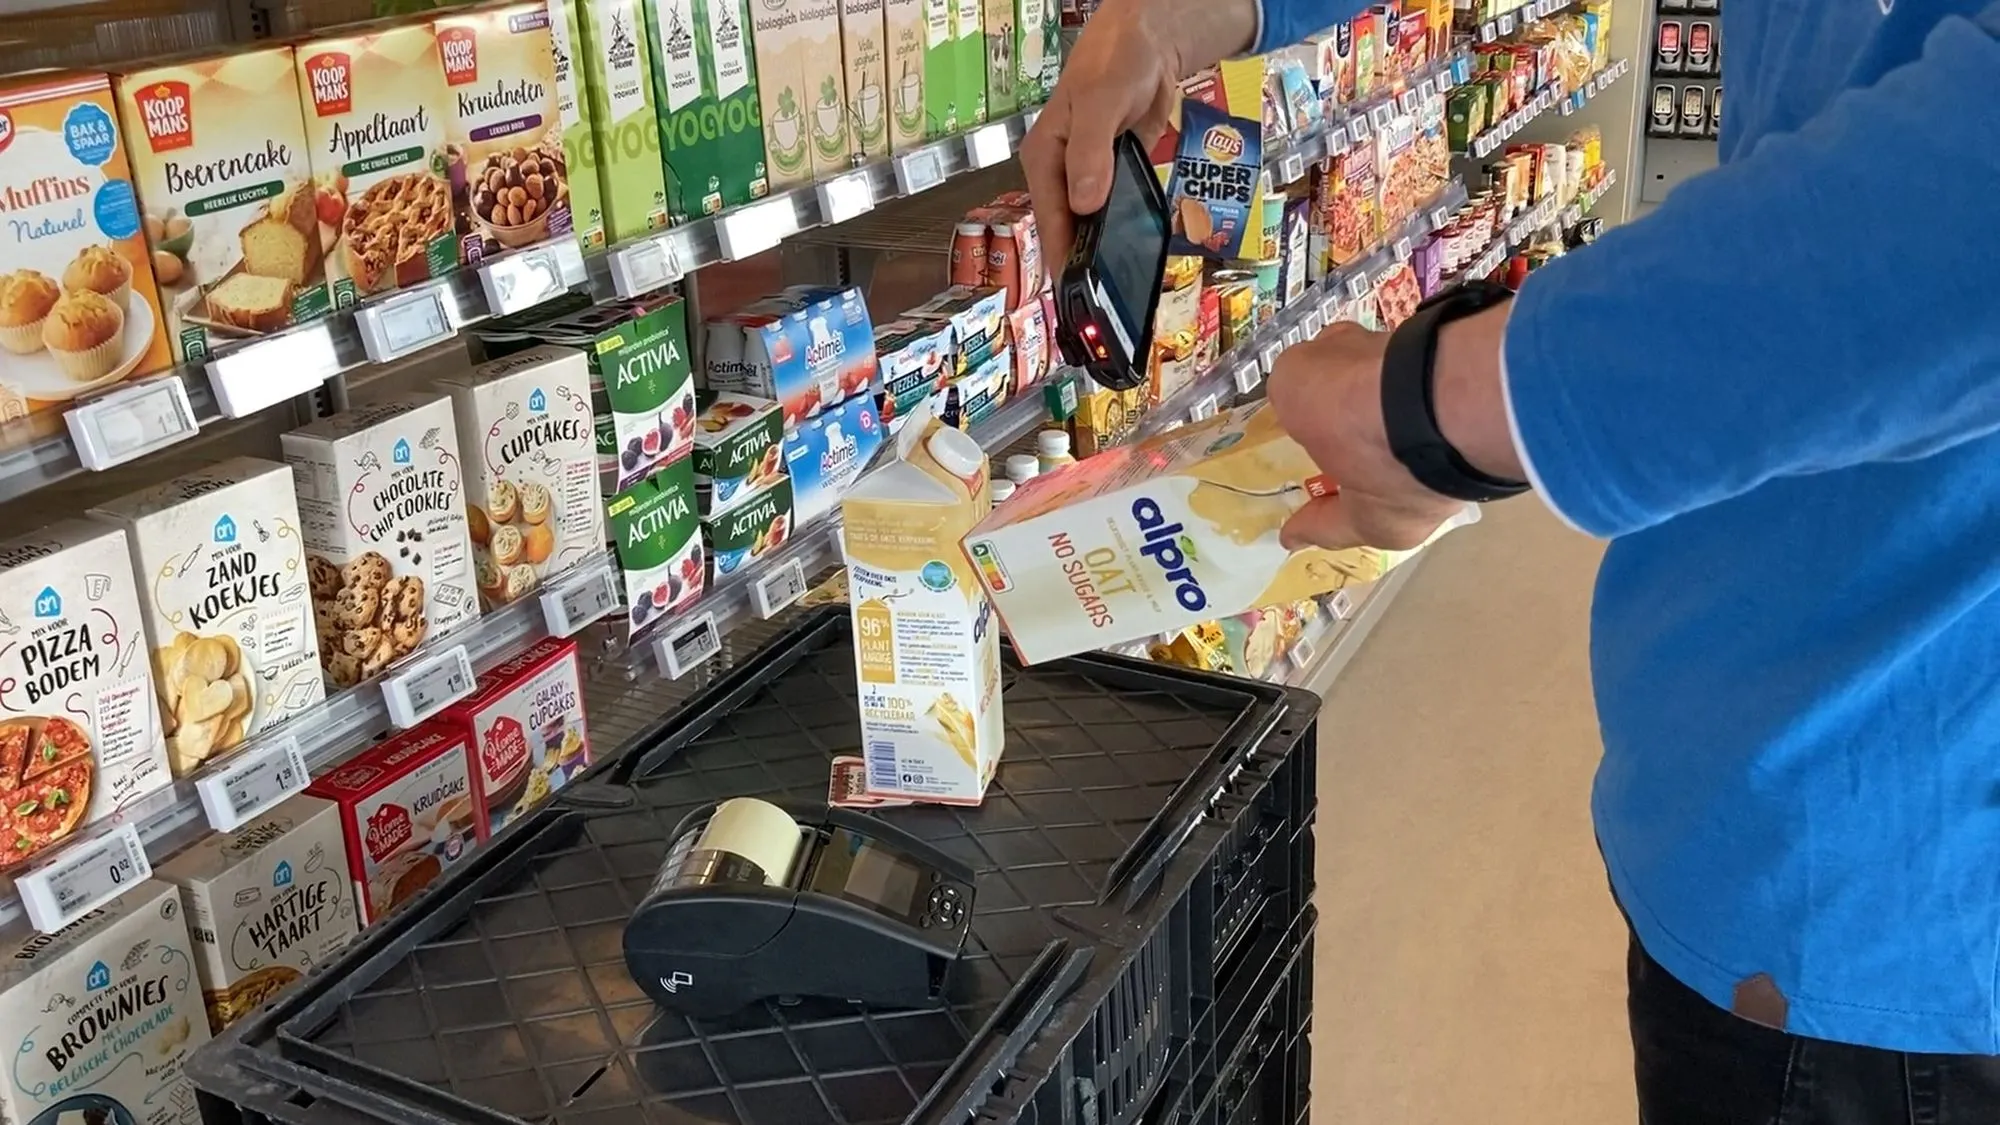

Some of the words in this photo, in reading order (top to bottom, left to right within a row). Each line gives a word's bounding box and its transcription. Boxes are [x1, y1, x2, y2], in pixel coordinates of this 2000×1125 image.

[756, 11, 797, 31] biologisch
[442, 38, 473, 57] KOOP
[445, 53, 475, 74] MANS
[312, 65, 346, 85] KOOP
[671, 77, 696, 89] YOGHURT
[674, 71, 691, 80] VOLLE
[720, 67, 743, 77] YOGHURT
[143, 96, 185, 120] KOOP
[315, 80, 348, 104] MANS
[458, 79, 545, 118] Kruidnoten
[613, 87, 639, 99] YOGHURT
[70, 122, 96, 138] BAK
[98, 118, 107, 132] &
[72, 132, 110, 151] SPAAR
[148, 114, 189, 138] MANS
[329, 105, 429, 159] Appeltaart
[165, 139, 292, 194] Boerencake
[1176, 159, 1251, 186] SUPER
[203, 195, 238, 211] HEERLIJK
[1184, 179, 1250, 203] CHIPS
[8, 208, 87, 243] Naturel
[617, 340, 680, 390] ACTIVIA
[500, 419, 580, 464] CUPCAKES
[729, 428, 772, 468] ACTIVIA
[372, 470, 444, 513] CHOCOLATE
[1308, 481, 1326, 497] NO
[369, 511, 395, 543] CHIP
[396, 491, 452, 522] COOKIES
[628, 495, 690, 549] ACTIVIA
[729, 501, 777, 542] ACTIVIA
[205, 551, 256, 589] ZAND
[1083, 546, 1137, 597] OAT
[1131, 497, 1206, 612] alpro
[1047, 531, 1075, 559] NO
[1062, 559, 1113, 628] SUGARS
[189, 572, 281, 630] KOEKJES
[20, 623, 93, 676] PIZZA
[31, 627, 46, 639] MIX
[24, 652, 100, 705] BODEM
[536, 680, 564, 706] GALAXY
[529, 691, 576, 731] CUPCAKES
[412, 776, 465, 815] KRUIDCAKE
[249, 881, 327, 948] HARTIGE
[262, 905, 324, 959] TAART
[46, 975, 168, 1072] BROWNIES
[67, 995, 103, 1026] COMPLETE
[49, 1049, 109, 1097] BELGISCHE
[112, 1003, 175, 1054] CHOCOLADE
